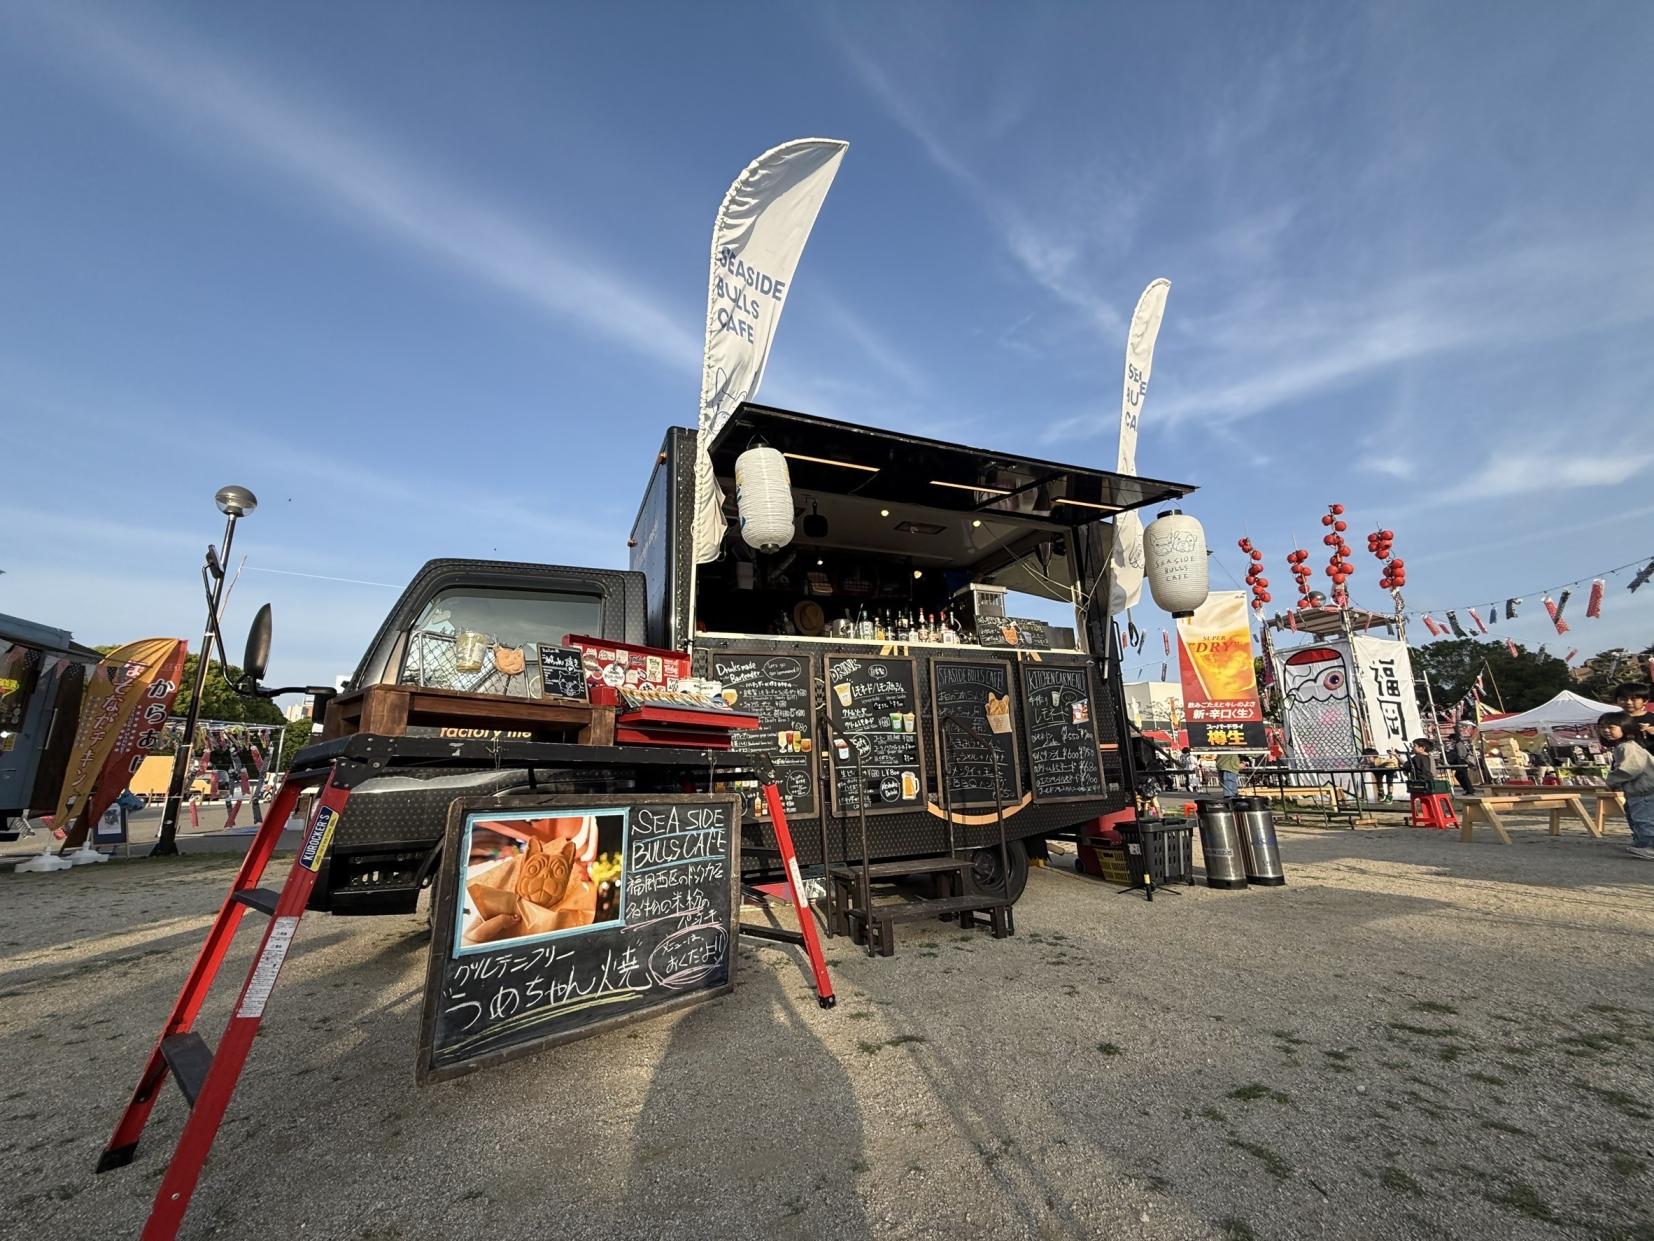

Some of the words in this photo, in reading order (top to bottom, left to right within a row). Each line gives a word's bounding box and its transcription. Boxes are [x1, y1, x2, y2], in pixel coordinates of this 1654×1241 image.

[719, 246, 786, 302] SEASIDE
[716, 275, 760, 320] BULLS
[717, 307, 754, 345] CAFE
[1207, 730, 1248, 746] 樽生
[303, 814, 330, 860] KUROCKER'S
[631, 805, 680, 836] SEA
[685, 808, 725, 830] SIDE
[632, 839, 681, 873] BULLS
[683, 826, 728, 858] CAFE
